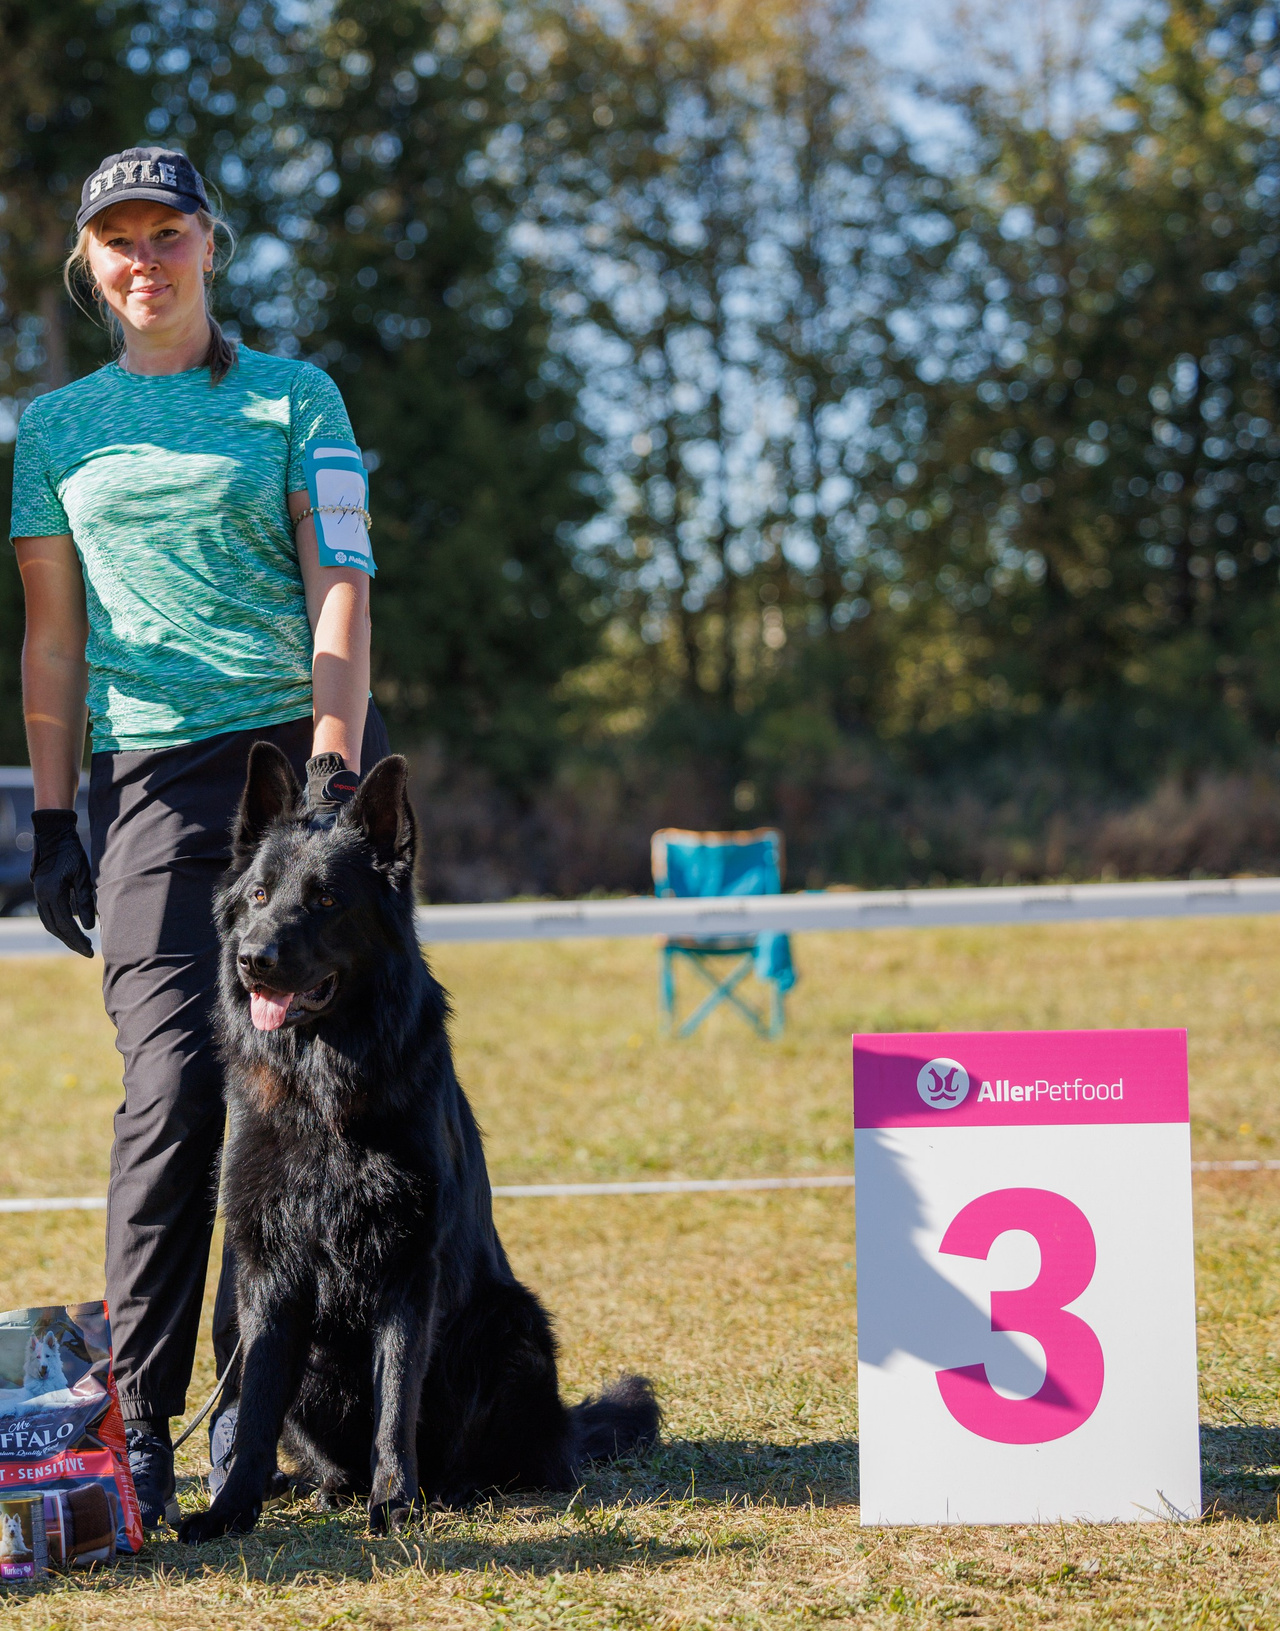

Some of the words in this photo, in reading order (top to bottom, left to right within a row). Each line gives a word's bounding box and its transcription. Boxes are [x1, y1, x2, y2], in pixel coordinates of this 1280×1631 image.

[89, 160, 177, 201] STYLE
[977, 1078, 1123, 1103] AllerPetfood
[935, 1187, 1106, 1447] 3
[8, 1420, 31, 1432] Mr
[18, 1457, 85, 1480] SENSITIVE
[3, 1566, 23, 1575] Turkey
